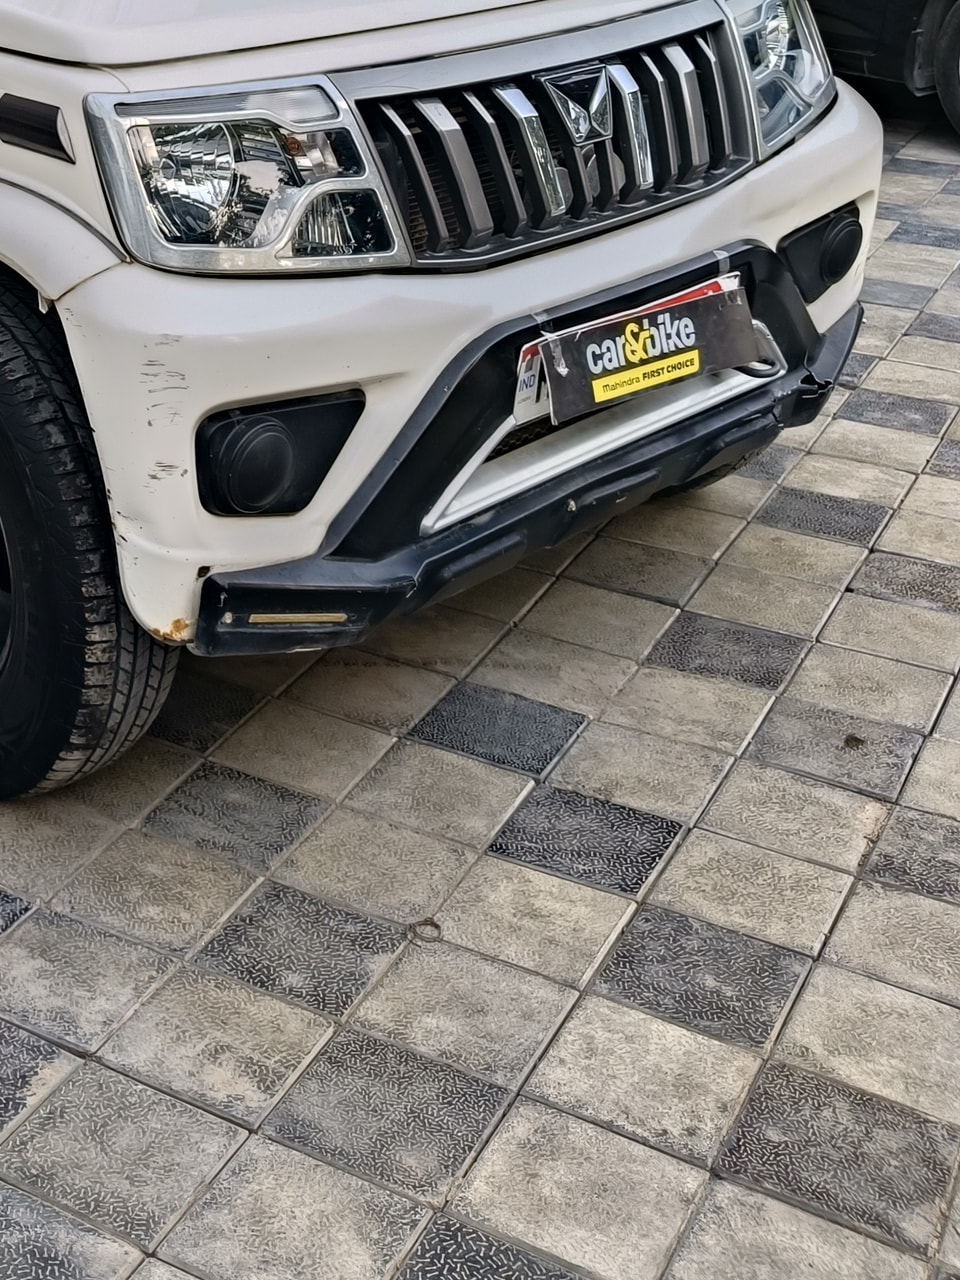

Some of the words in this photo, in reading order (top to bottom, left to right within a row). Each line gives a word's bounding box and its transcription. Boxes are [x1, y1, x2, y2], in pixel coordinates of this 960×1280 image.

[586, 312, 696, 375] car&bike
[518, 373, 536, 393] IND
[602, 376, 641, 394] Mahindra
[642, 367, 665, 381] FIRST
[666, 358, 695, 374] CHOICE
